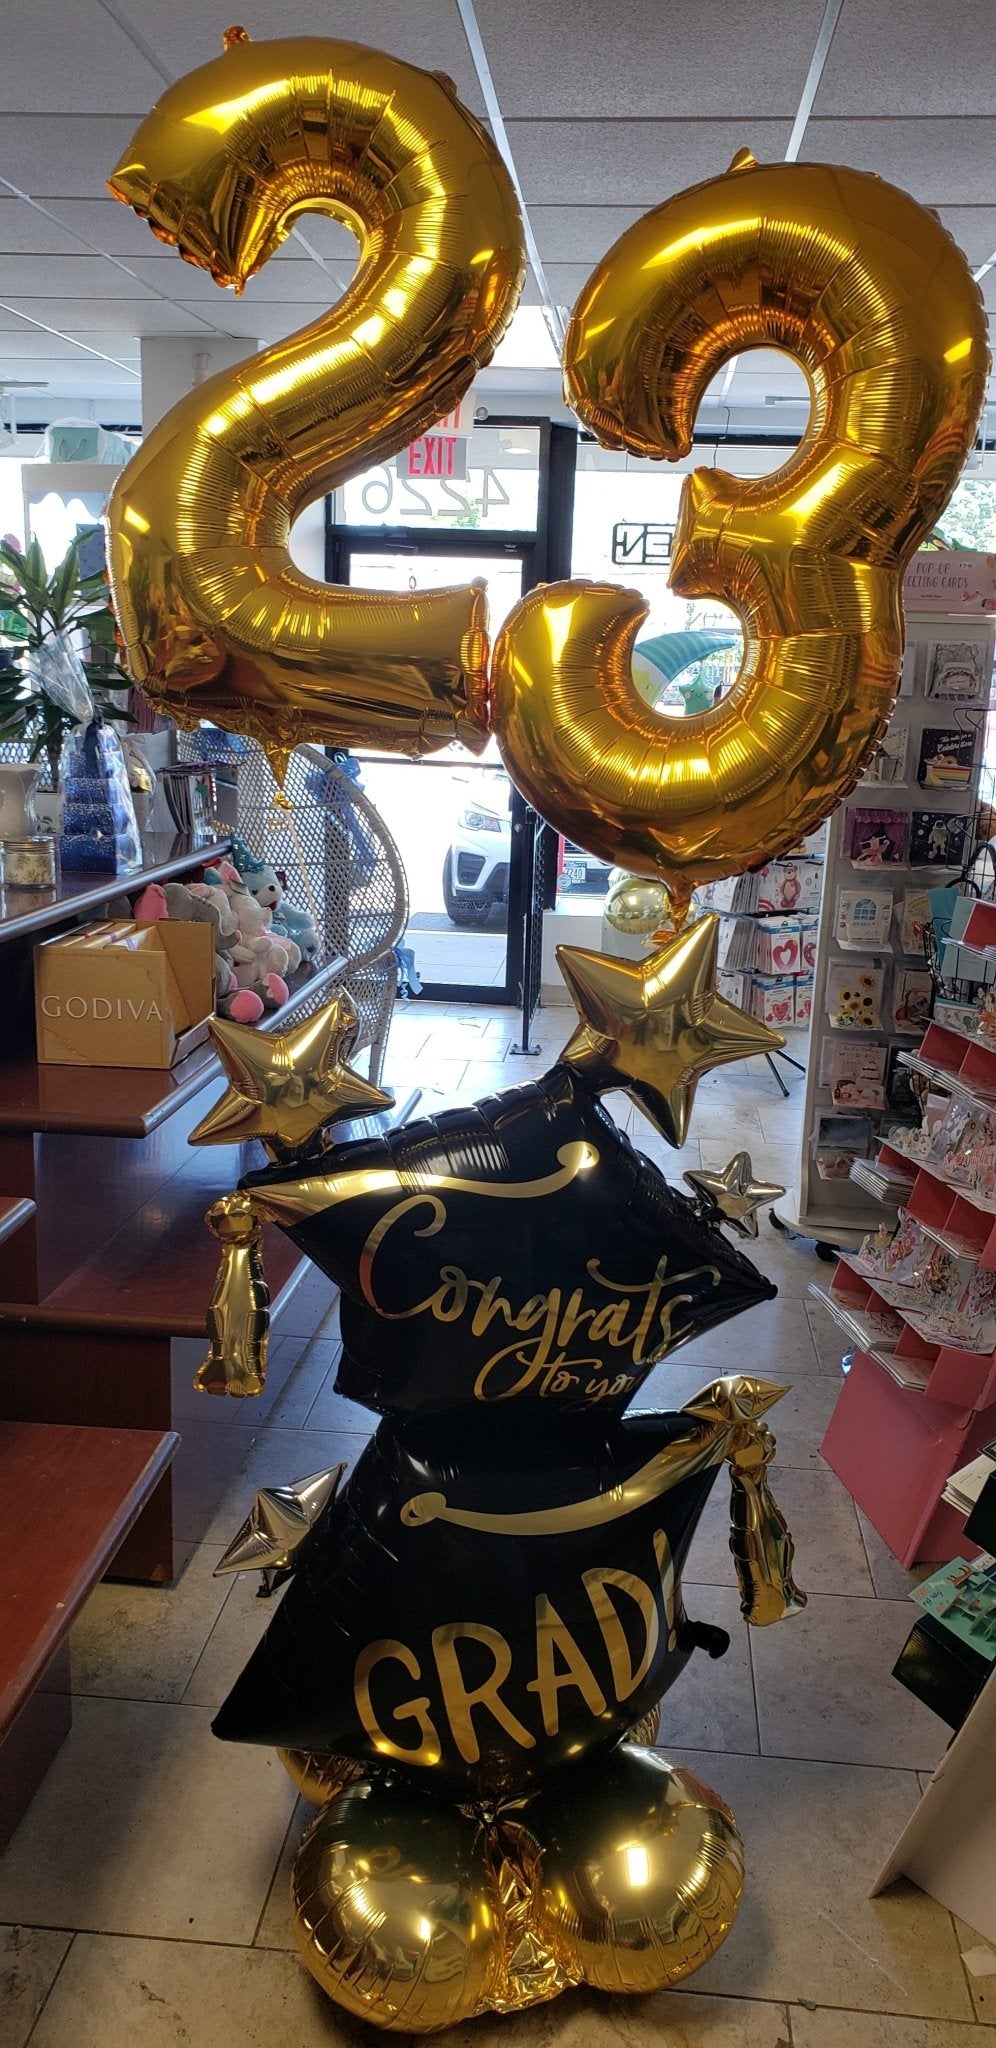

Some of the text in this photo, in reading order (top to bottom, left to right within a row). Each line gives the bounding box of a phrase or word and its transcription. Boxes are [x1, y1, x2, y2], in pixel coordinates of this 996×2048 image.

[408, 437, 457, 475] EXIT
[941, 577, 969, 589] CARDS
[41, 995, 163, 1022] GODIVA
[358, 1194, 721, 1401] Congrats
[516, 1351, 602, 1398] to
[353, 1528, 679, 1767] GRAD!
